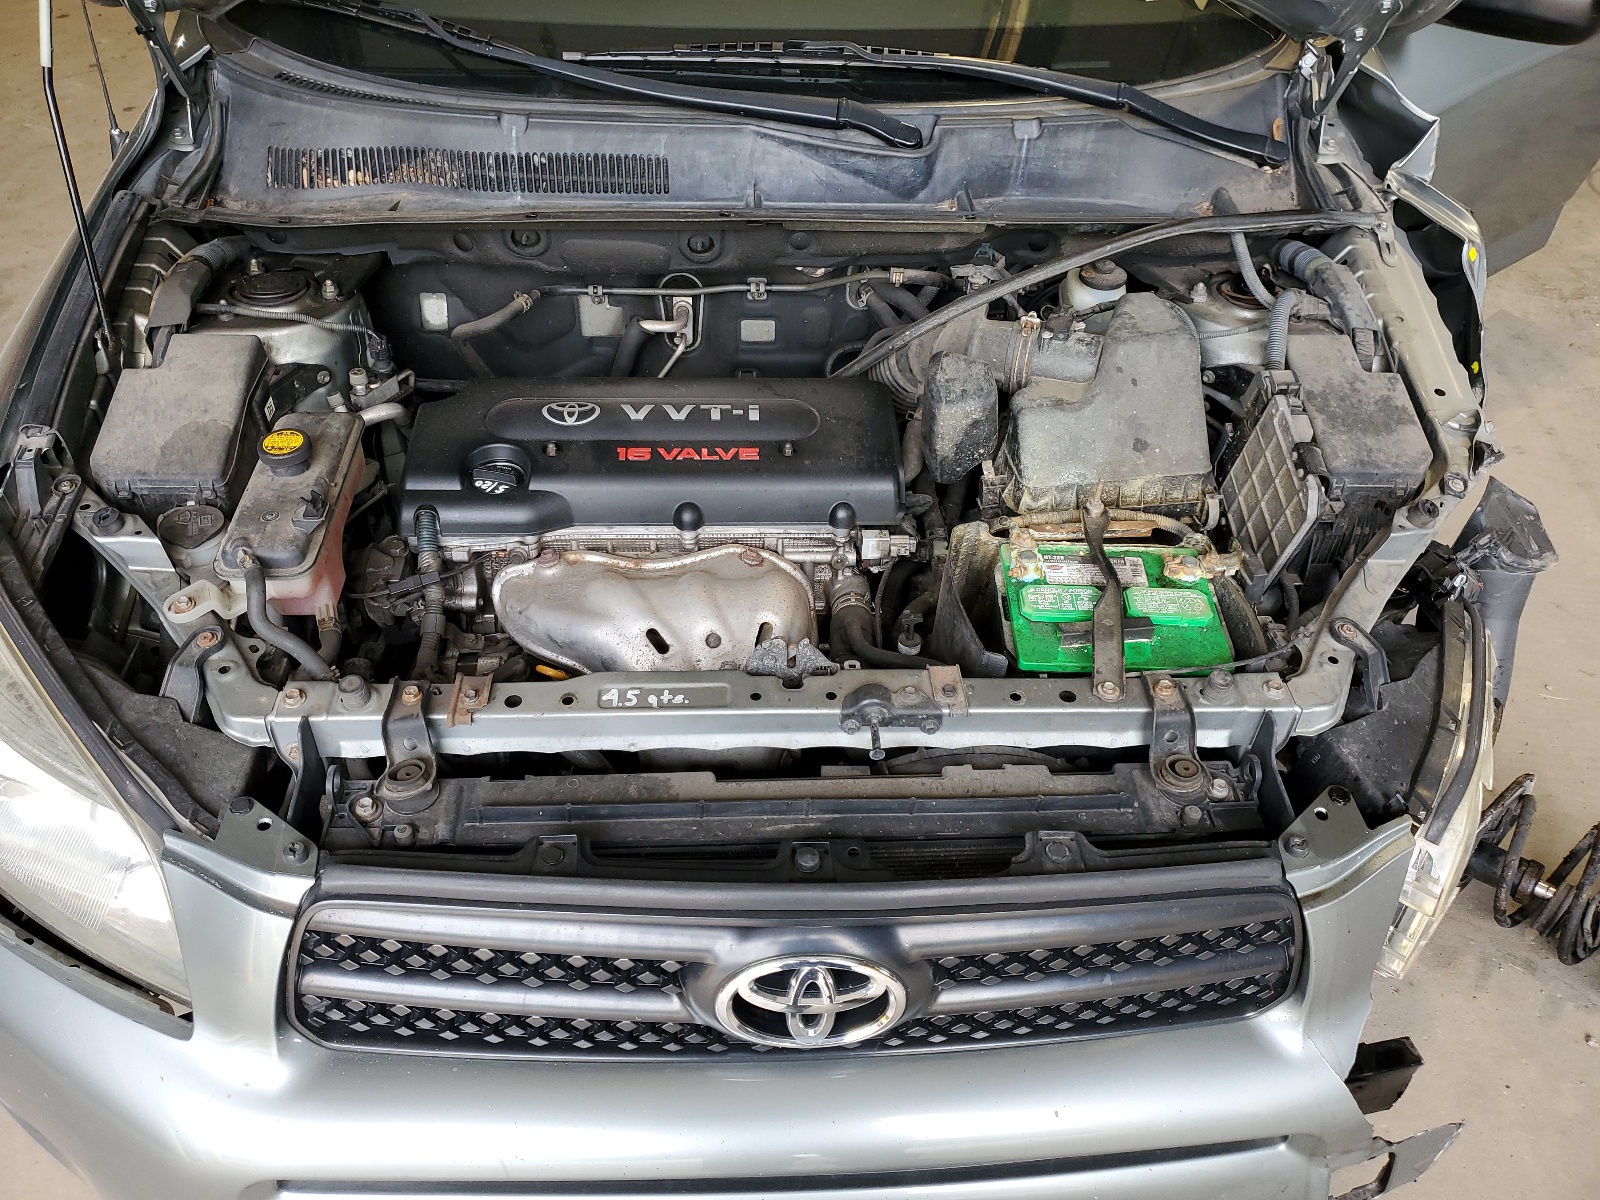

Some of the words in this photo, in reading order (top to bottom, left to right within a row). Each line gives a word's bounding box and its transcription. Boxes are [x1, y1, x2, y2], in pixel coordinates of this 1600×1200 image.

[620, 404, 760, 421] VVT-i
[617, 447, 651, 461] 16
[657, 447, 760, 461] VALVE
[601, 688, 641, 707] 4.5
[647, 689, 690, 709] qts.
